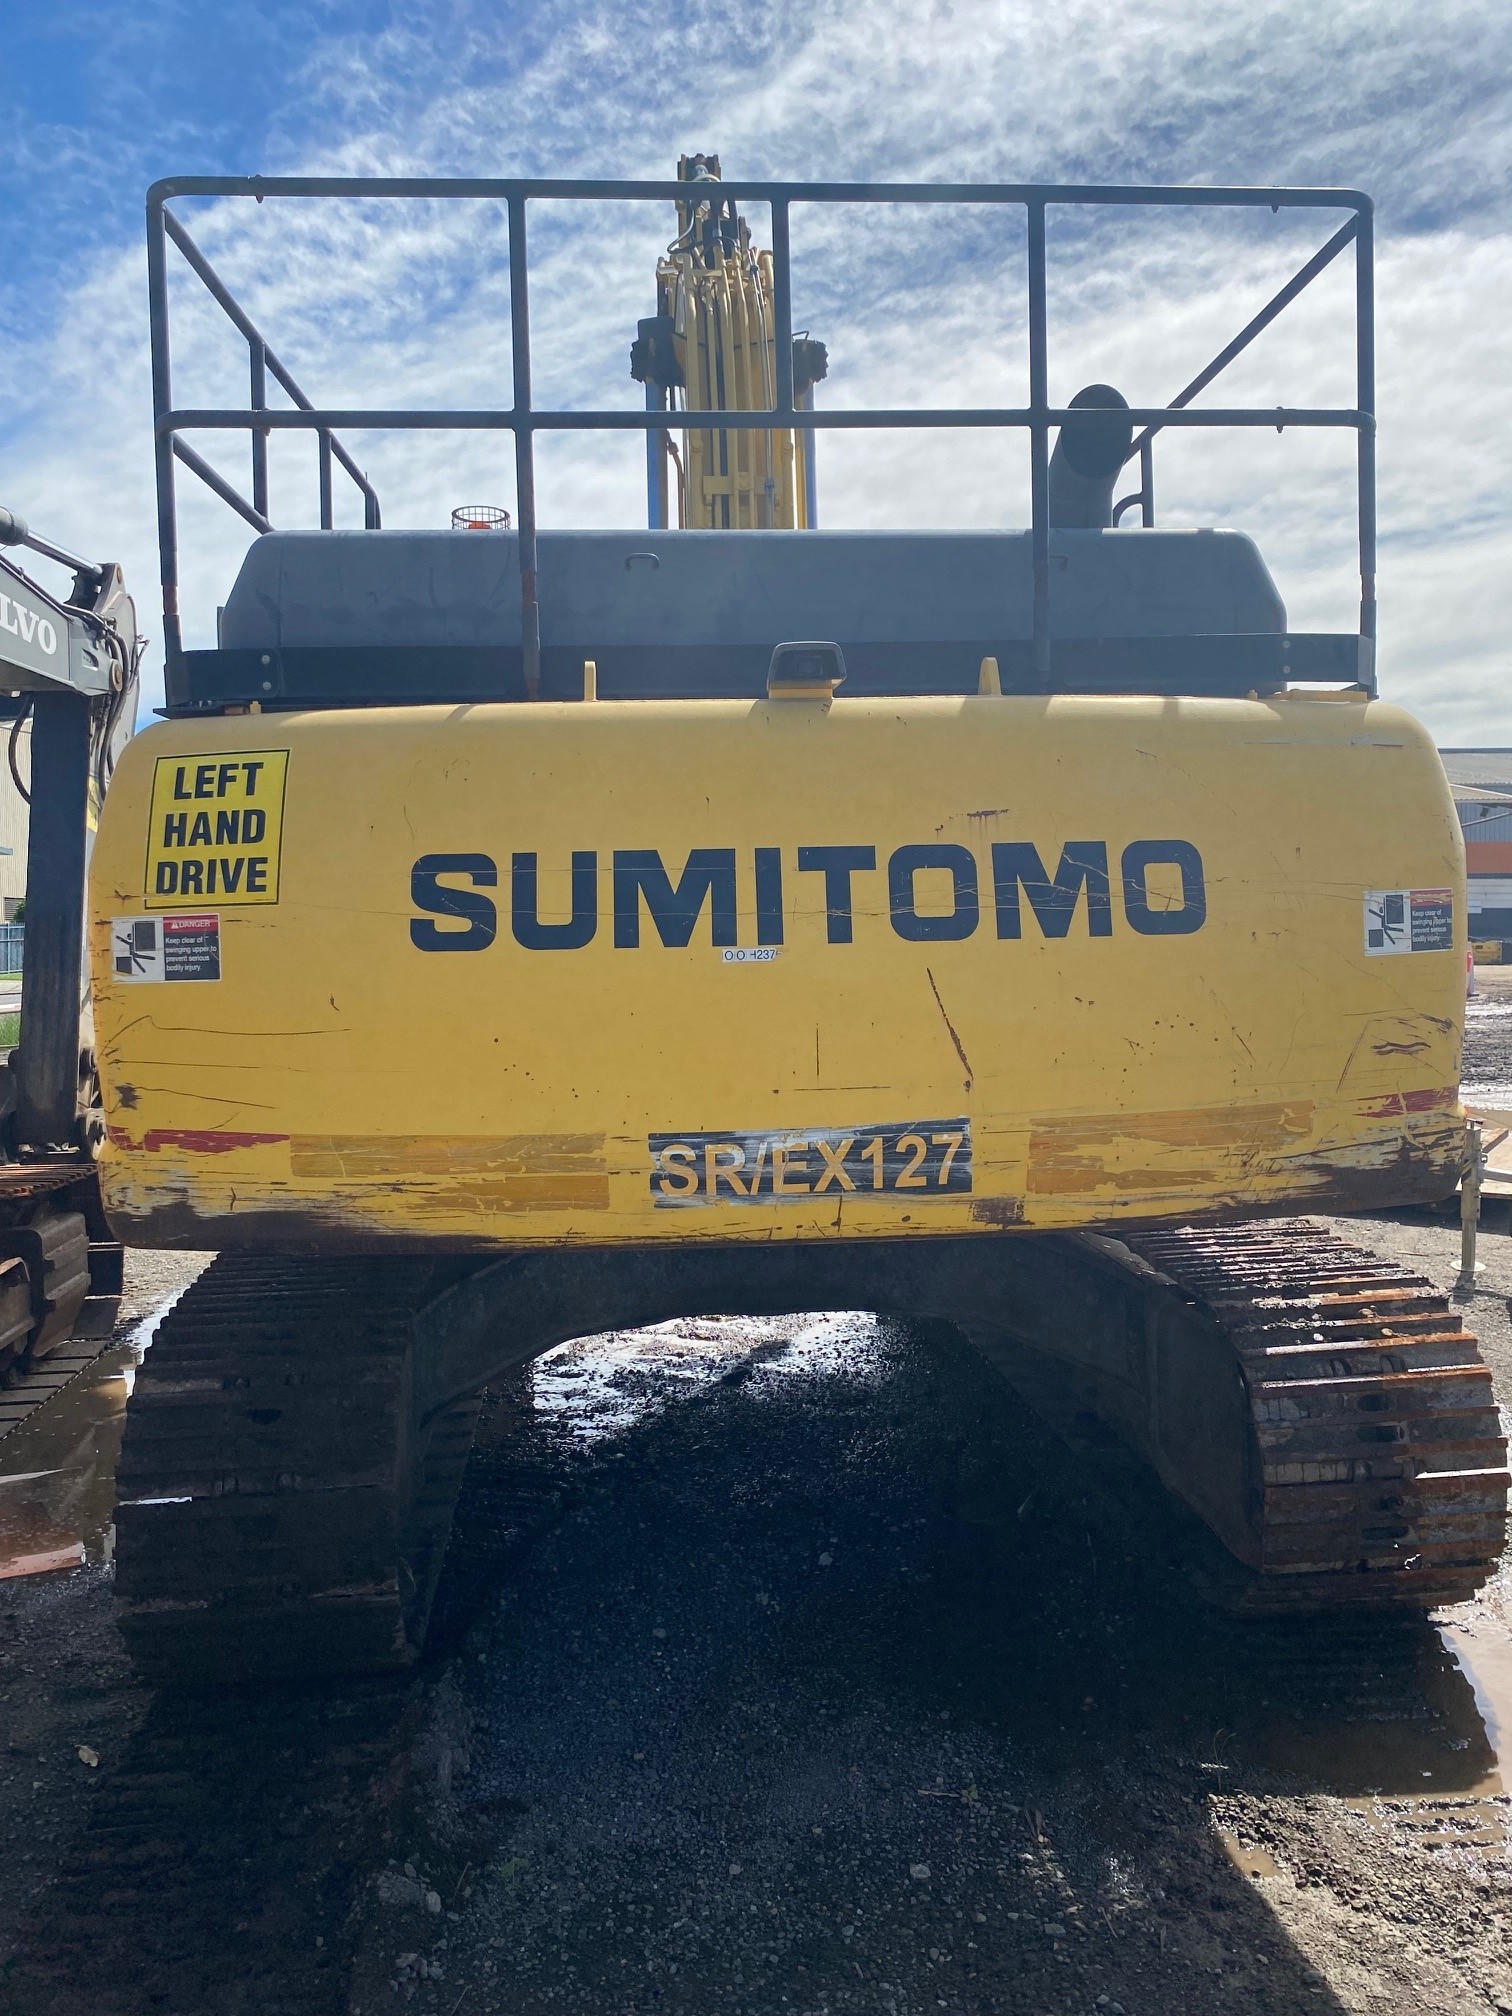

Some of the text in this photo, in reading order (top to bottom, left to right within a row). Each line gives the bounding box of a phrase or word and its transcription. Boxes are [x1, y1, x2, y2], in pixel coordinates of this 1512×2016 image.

[173, 762, 264, 800] LEFT
[163, 809, 266, 848] HAND
[156, 857, 268, 895] DRIVE
[409, 839, 1207, 952] SUMITOMO
[179, 919, 211, 928] DANGER
[165, 937, 180, 945] Keep
[181, 936, 196, 944] clear
[165, 946, 191, 955] swinging
[192, 946, 209, 954] upper
[166, 955, 188, 963] prevent
[166, 964, 184, 972] bodily
[658, 1133, 964, 1196] SR/EX127
